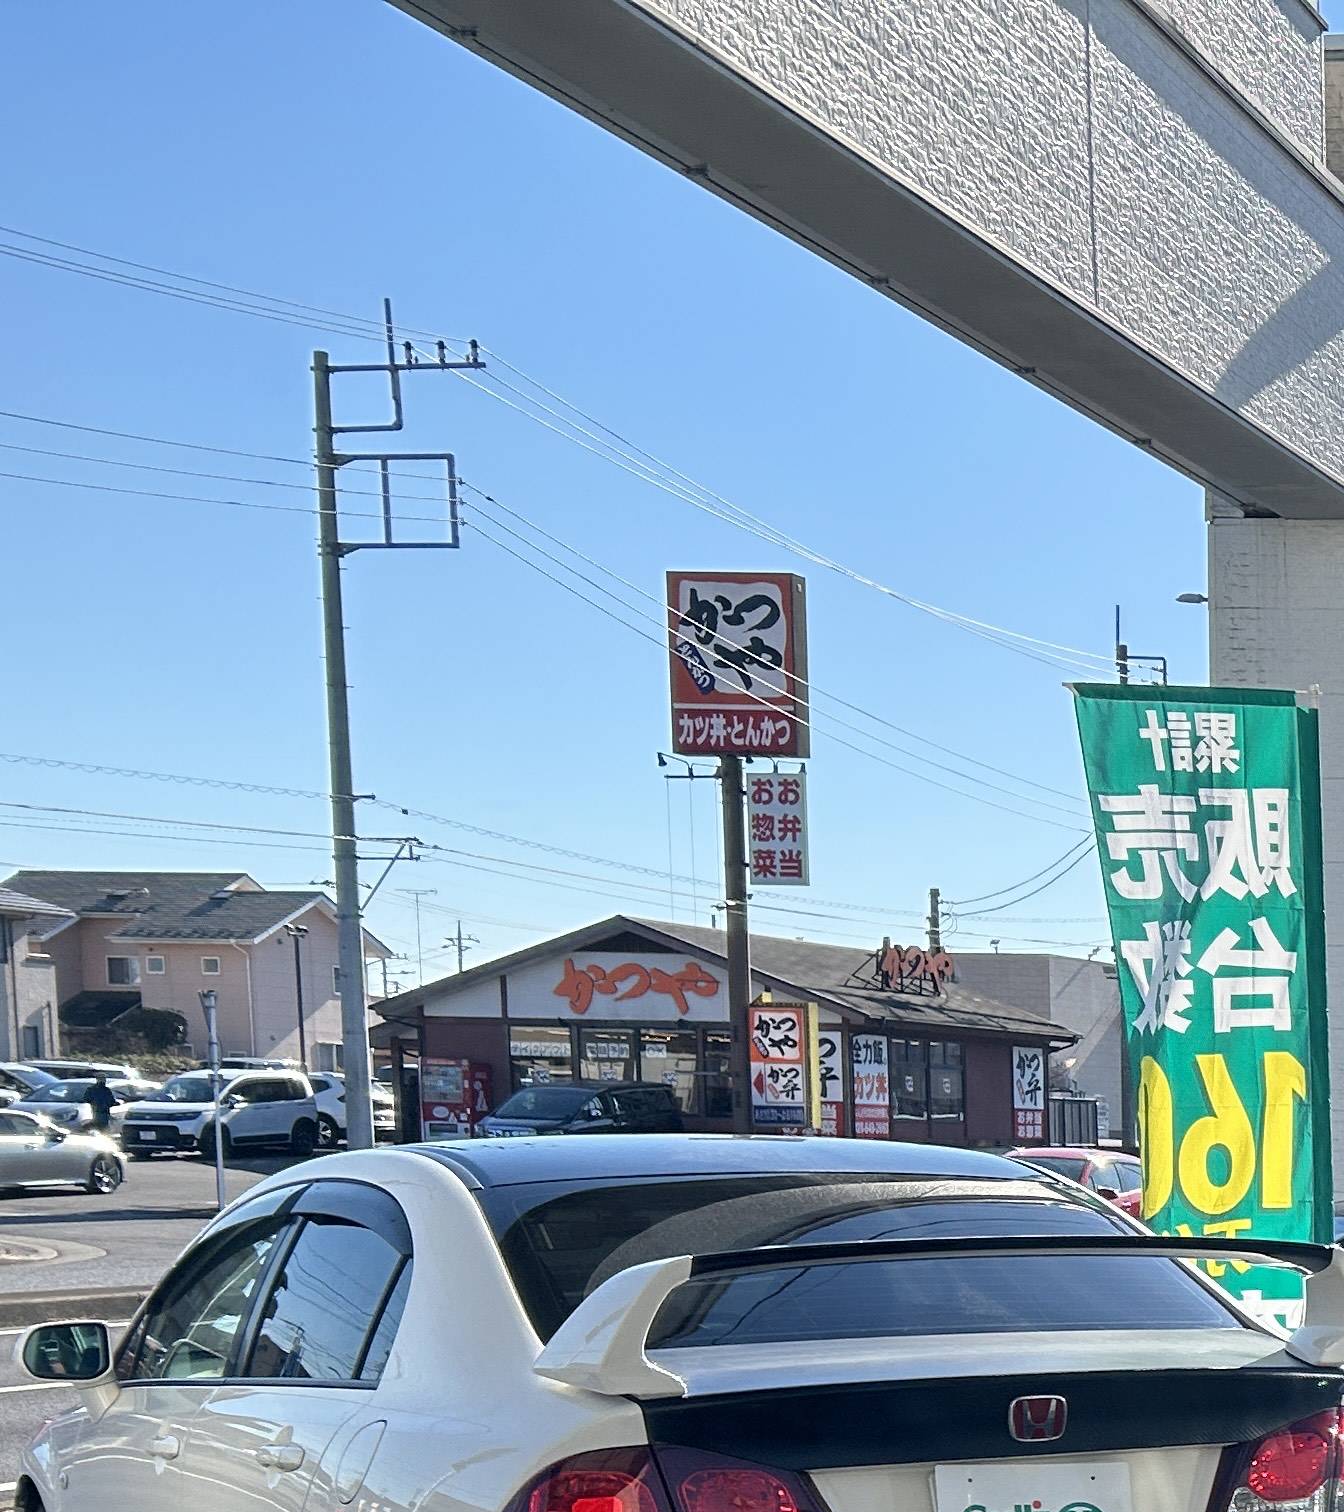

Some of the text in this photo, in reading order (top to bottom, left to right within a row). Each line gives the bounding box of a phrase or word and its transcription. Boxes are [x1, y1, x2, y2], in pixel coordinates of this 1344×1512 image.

[751, 779, 777, 878] お惣菜
[778, 779, 803, 878] お弁当
[553, 958, 720, 1015] かつや
